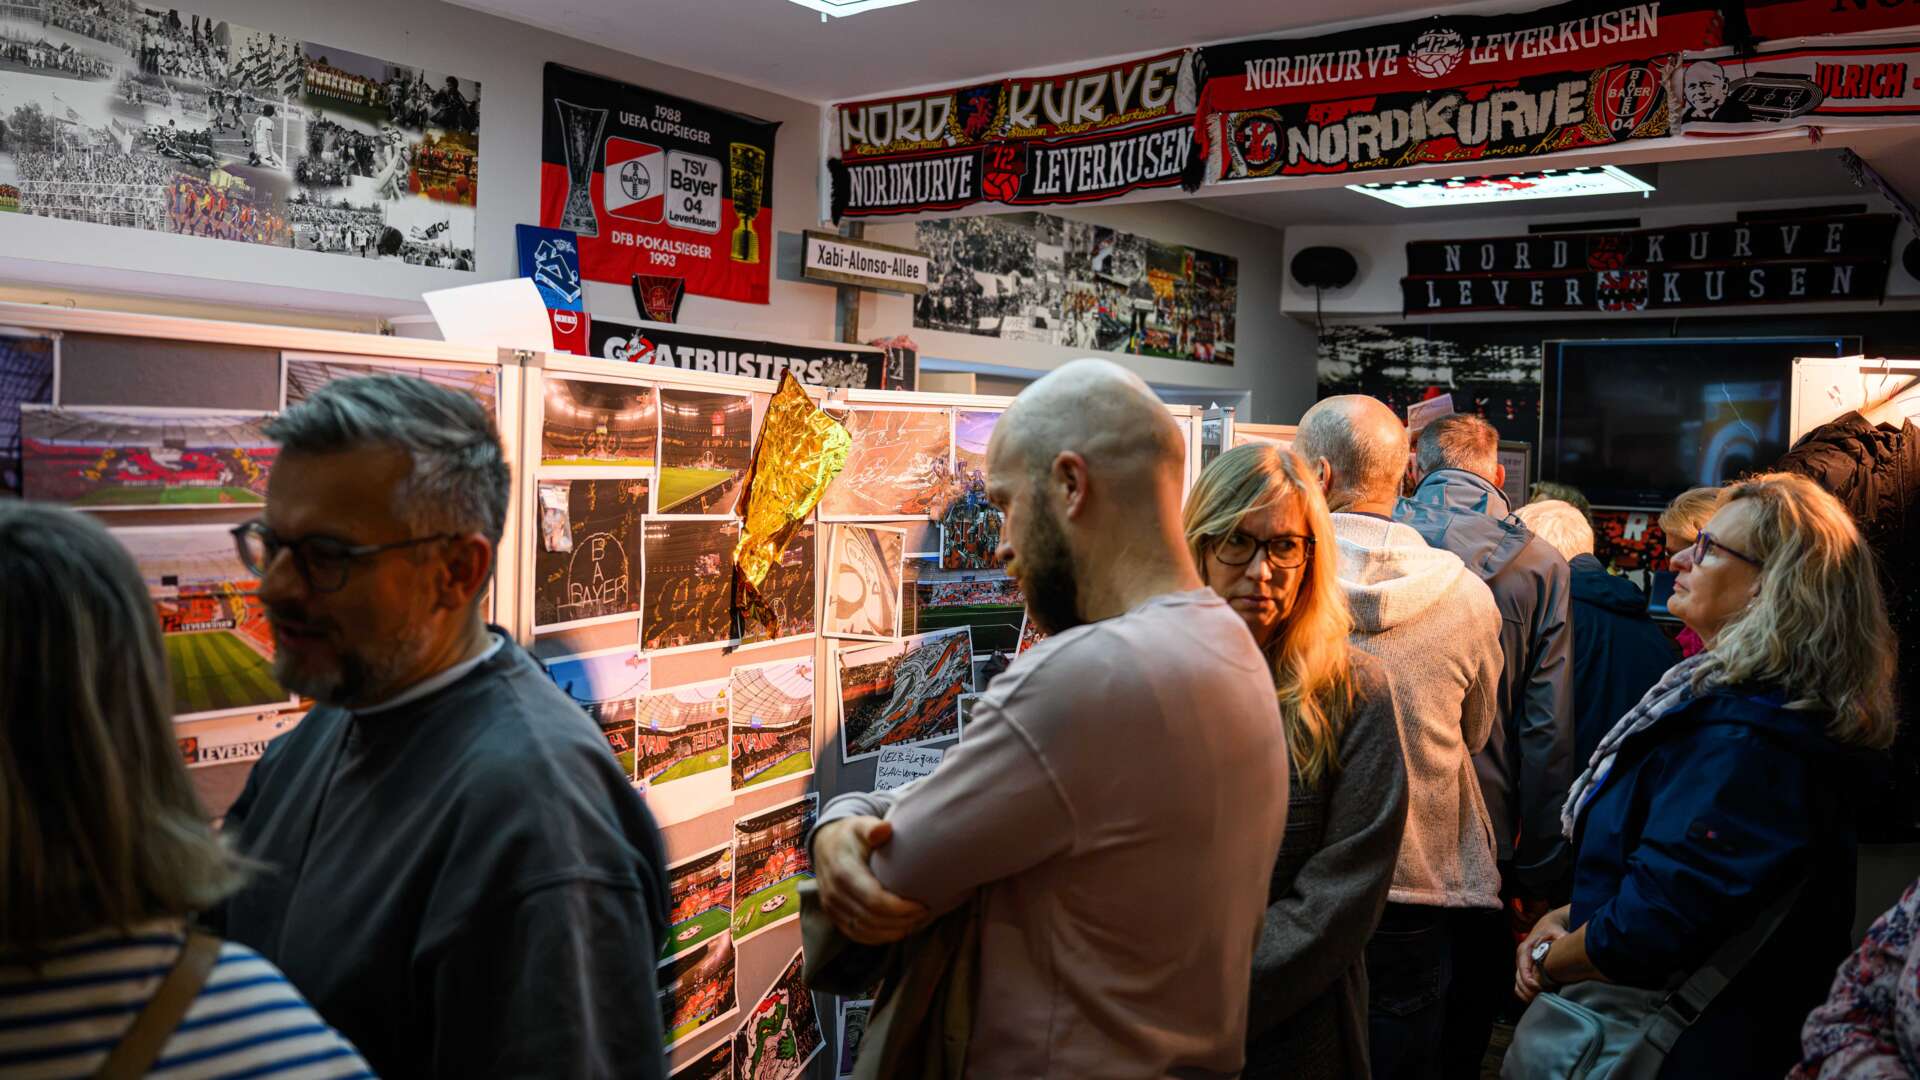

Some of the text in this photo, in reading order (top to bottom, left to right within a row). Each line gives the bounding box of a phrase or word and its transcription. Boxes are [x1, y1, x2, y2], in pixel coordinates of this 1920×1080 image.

[1244, 44, 1400, 91] NORDKURVE
[1469, 2, 1660, 64] LEVERKUSEN
[1815, 62, 1906, 99] ULRICH
[655, 105, 682, 122] 1988
[841, 56, 1181, 150] NORD KURVE
[619, 111, 711, 144] UEFA CUPSIEGER
[1287, 80, 1587, 165] NORDKURVE
[1611, 118, 1635, 131] 04
[682, 159, 707, 176] TSV
[848, 155, 974, 207] NORDKURVE
[993, 146, 1016, 170] 12
[1033, 126, 1195, 195] LEVERKUSEN
[671, 170, 718, 197] Bayer
[669, 210, 717, 228] Leverkusen
[684, 197, 703, 214] 04
[611, 231, 712, 259] DFB POKALSIEGER
[650, 251, 676, 267] 1993
[1445, 241, 1568, 272] NORD
[1646, 224, 1844, 263] KURVE
[817, 244, 919, 278] Xabi-Alonso-Allee
[1427, 266, 1854, 307] LEVER KUSEN
[199, 741, 269, 762] LEVERKU
